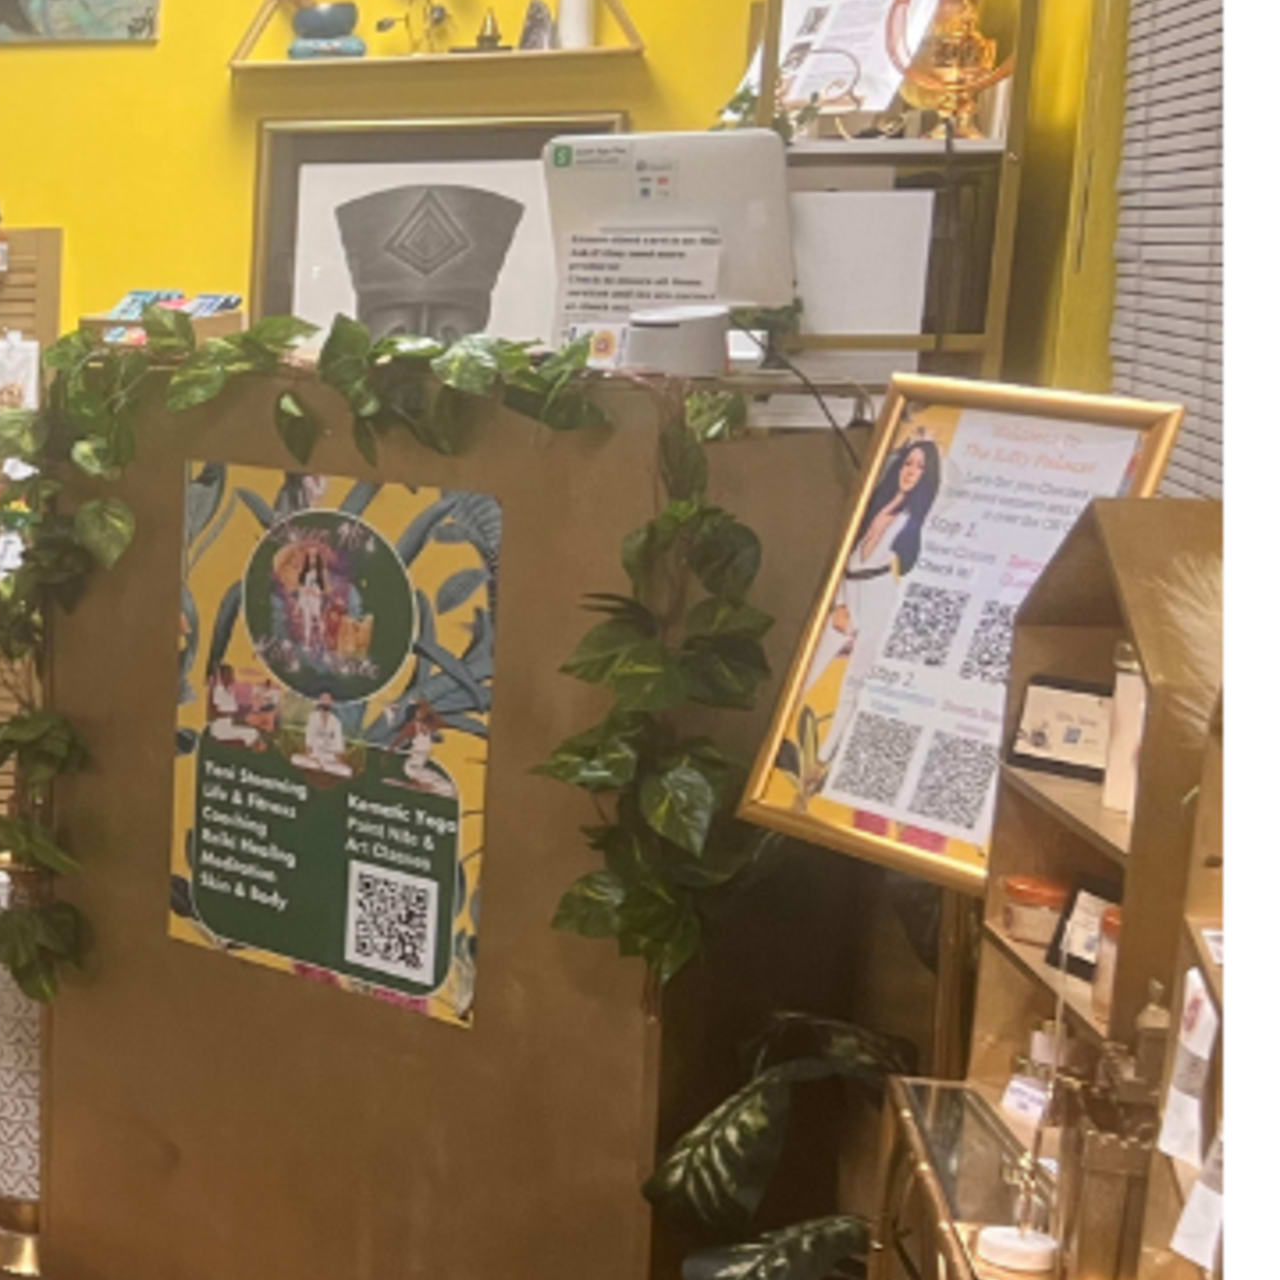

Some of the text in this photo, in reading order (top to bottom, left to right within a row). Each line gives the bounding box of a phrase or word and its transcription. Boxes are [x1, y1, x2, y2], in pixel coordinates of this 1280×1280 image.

[928, 515, 963, 537] Step
[231, 788, 242, 805] &
[247, 791, 297, 819] Fitness
[202, 805, 268, 838] Coaching
[414, 808, 458, 836] Yoga
[241, 837, 297, 869] Healing
[344, 837, 370, 855] Art
[422, 834, 436, 852] &
[200, 849, 277, 883] Meditation
[200, 871, 289, 912] Skin & Body
